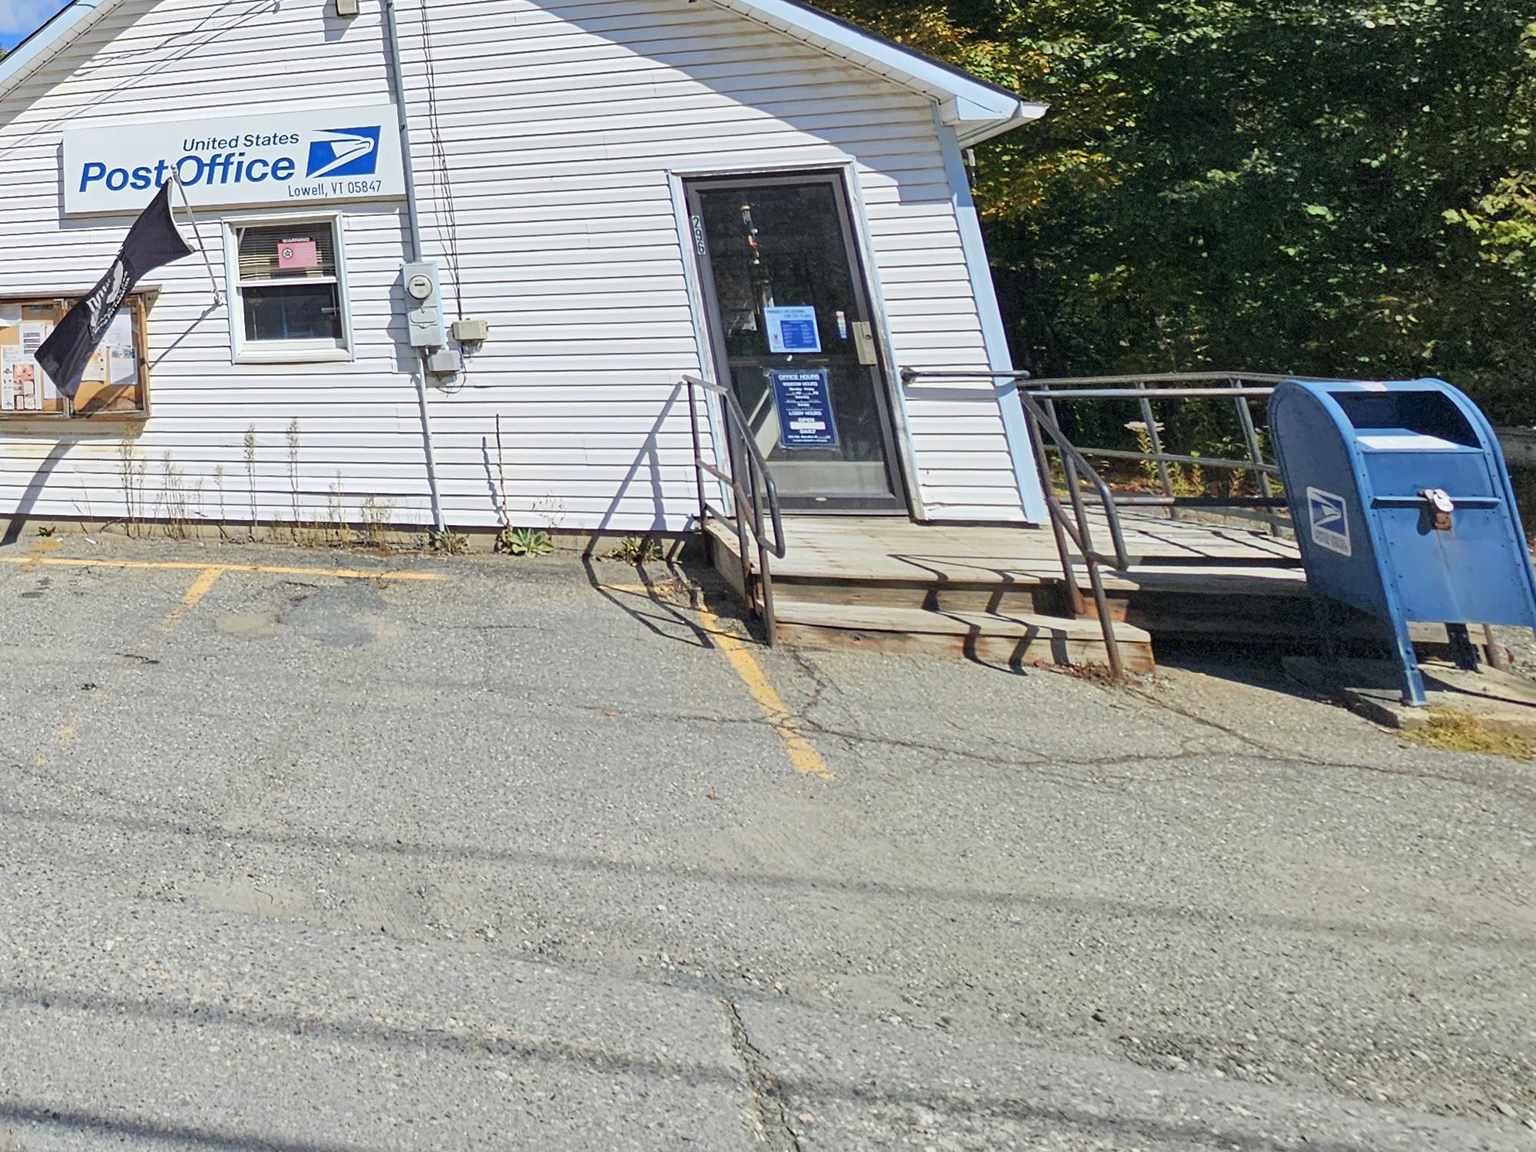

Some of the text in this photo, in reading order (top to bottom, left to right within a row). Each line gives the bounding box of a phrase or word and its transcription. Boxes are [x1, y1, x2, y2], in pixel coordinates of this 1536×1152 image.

[183, 132, 300, 152] United States
[79, 152, 296, 193] Post Office
[287, 180, 382, 197] Lowell, VT 05847
[693, 216, 705, 255] 296
